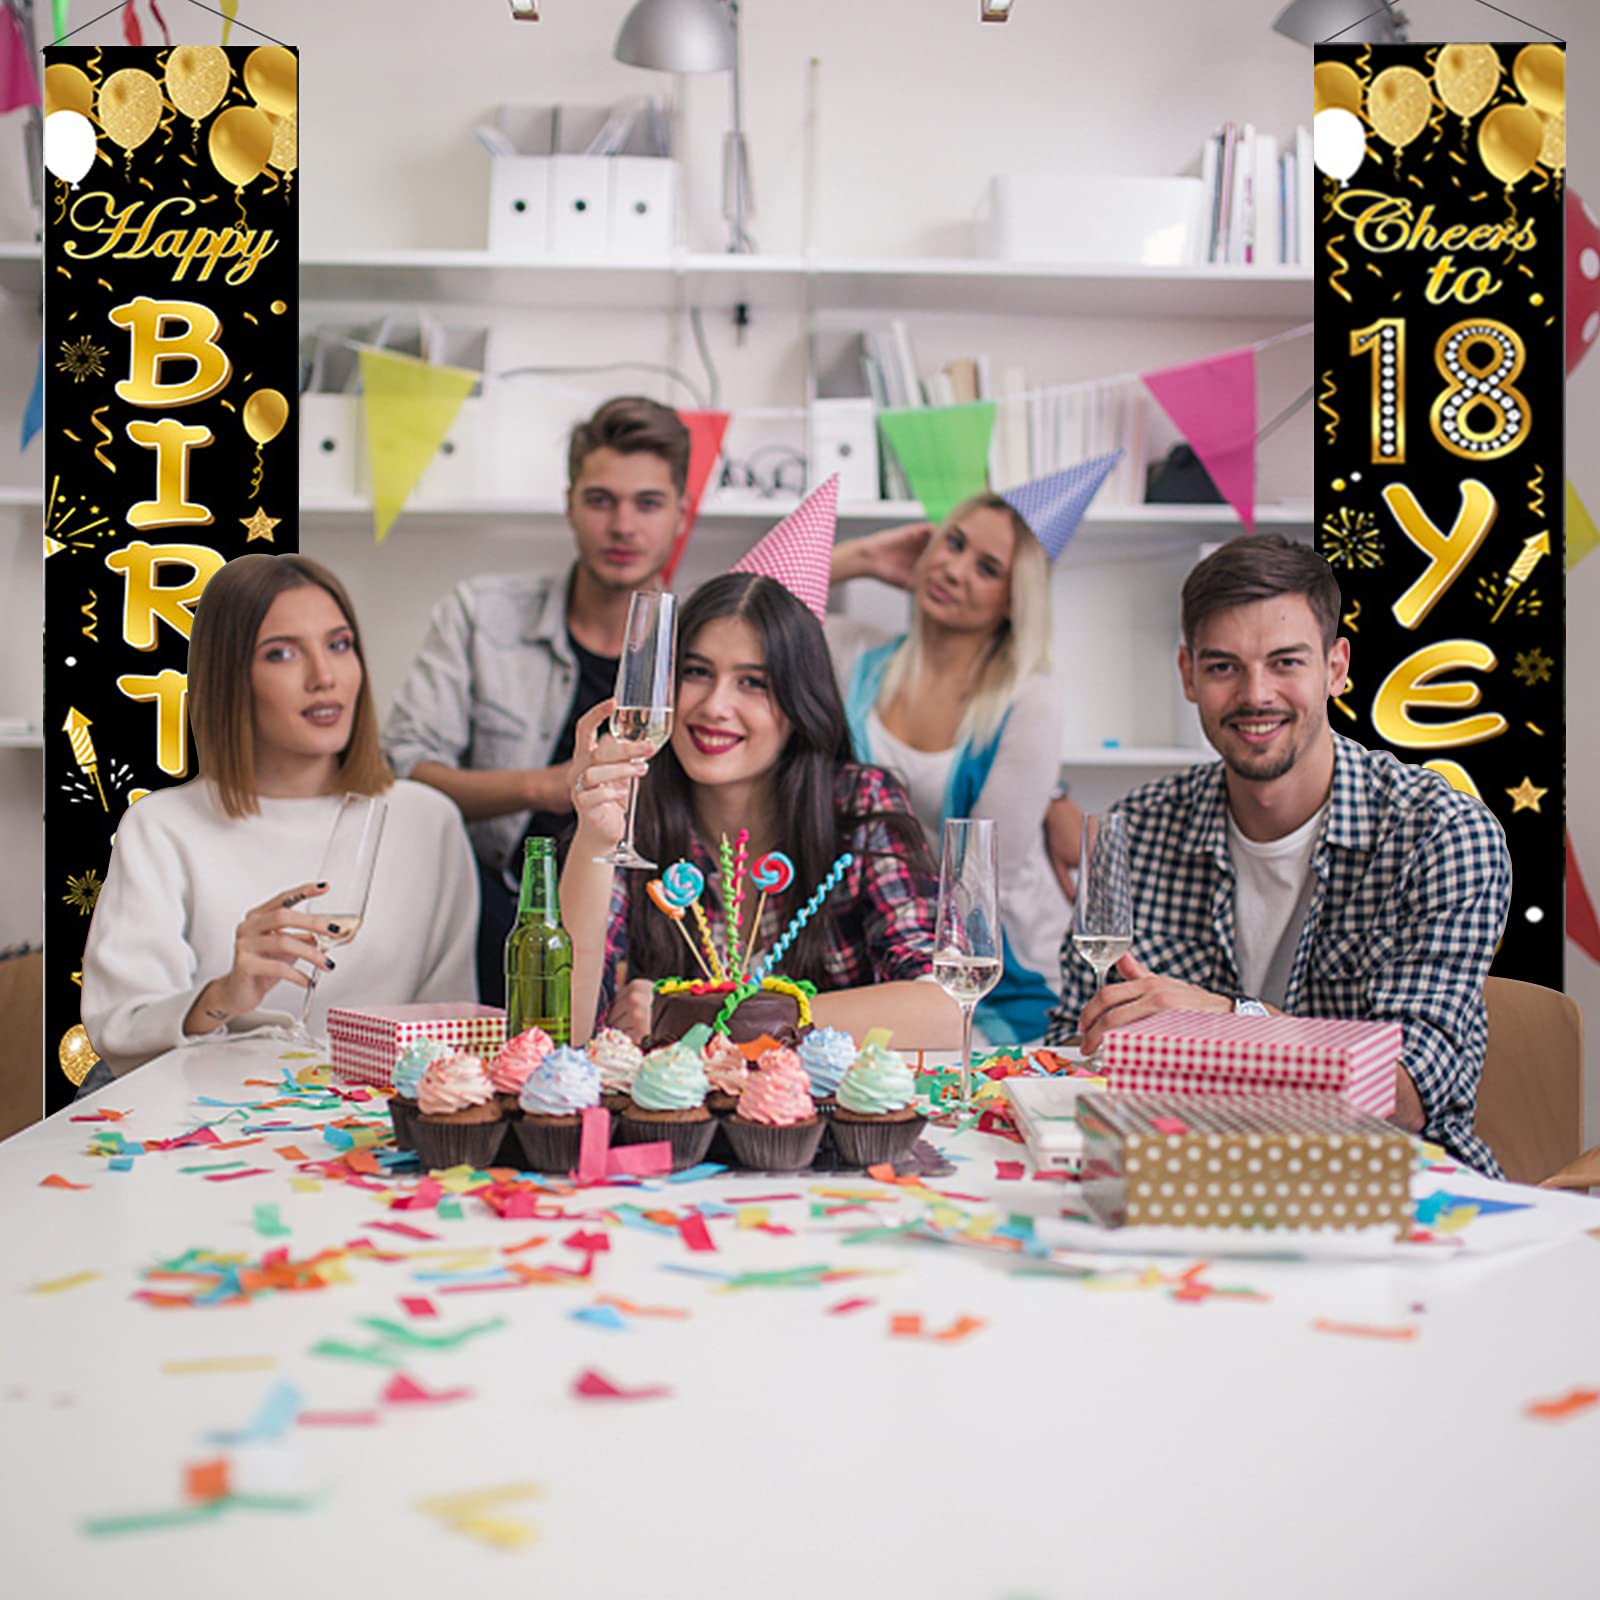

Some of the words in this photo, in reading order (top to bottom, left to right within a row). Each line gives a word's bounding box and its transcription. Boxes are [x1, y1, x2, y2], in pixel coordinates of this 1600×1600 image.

[63, 191, 280, 286] Happy
[1332, 189, 1538, 253] Cheers
[1424, 255, 1503, 305] to
[1349, 317, 1533, 465] 18
[107, 296, 233, 847] BIRT
